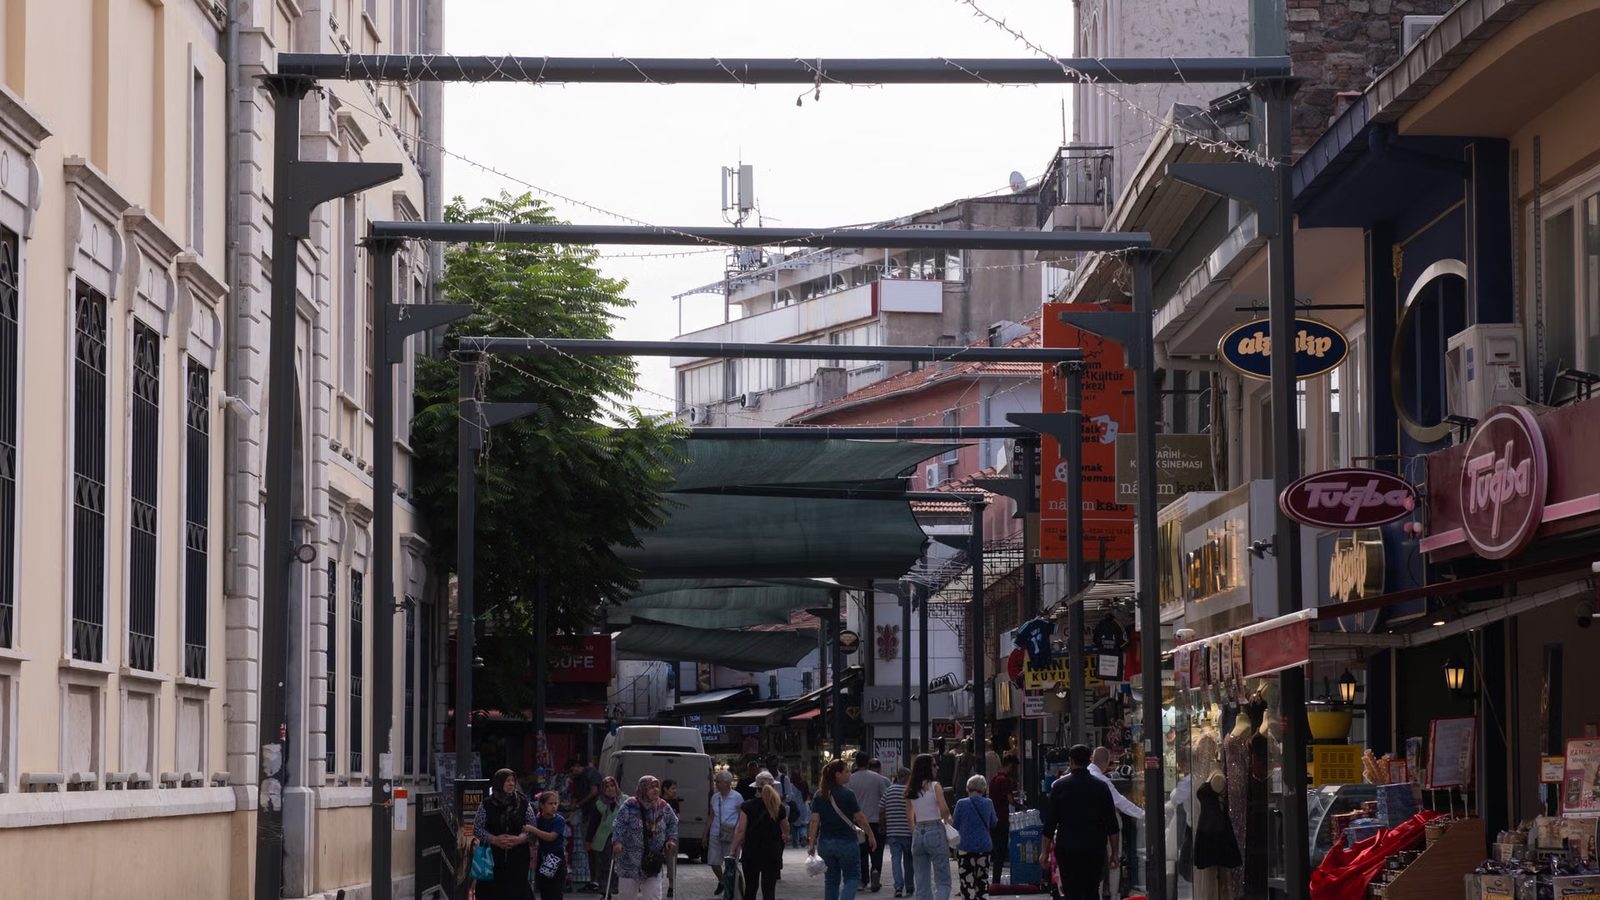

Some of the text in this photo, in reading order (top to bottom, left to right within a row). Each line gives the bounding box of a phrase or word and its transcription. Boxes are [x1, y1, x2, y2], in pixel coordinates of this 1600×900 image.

[1091, 369, 1125, 382] Kültür
[1161, 459, 1203, 469] SİNEMASI
[868, 697, 896, 713] 1943
[935, 723, 954, 733] WC
